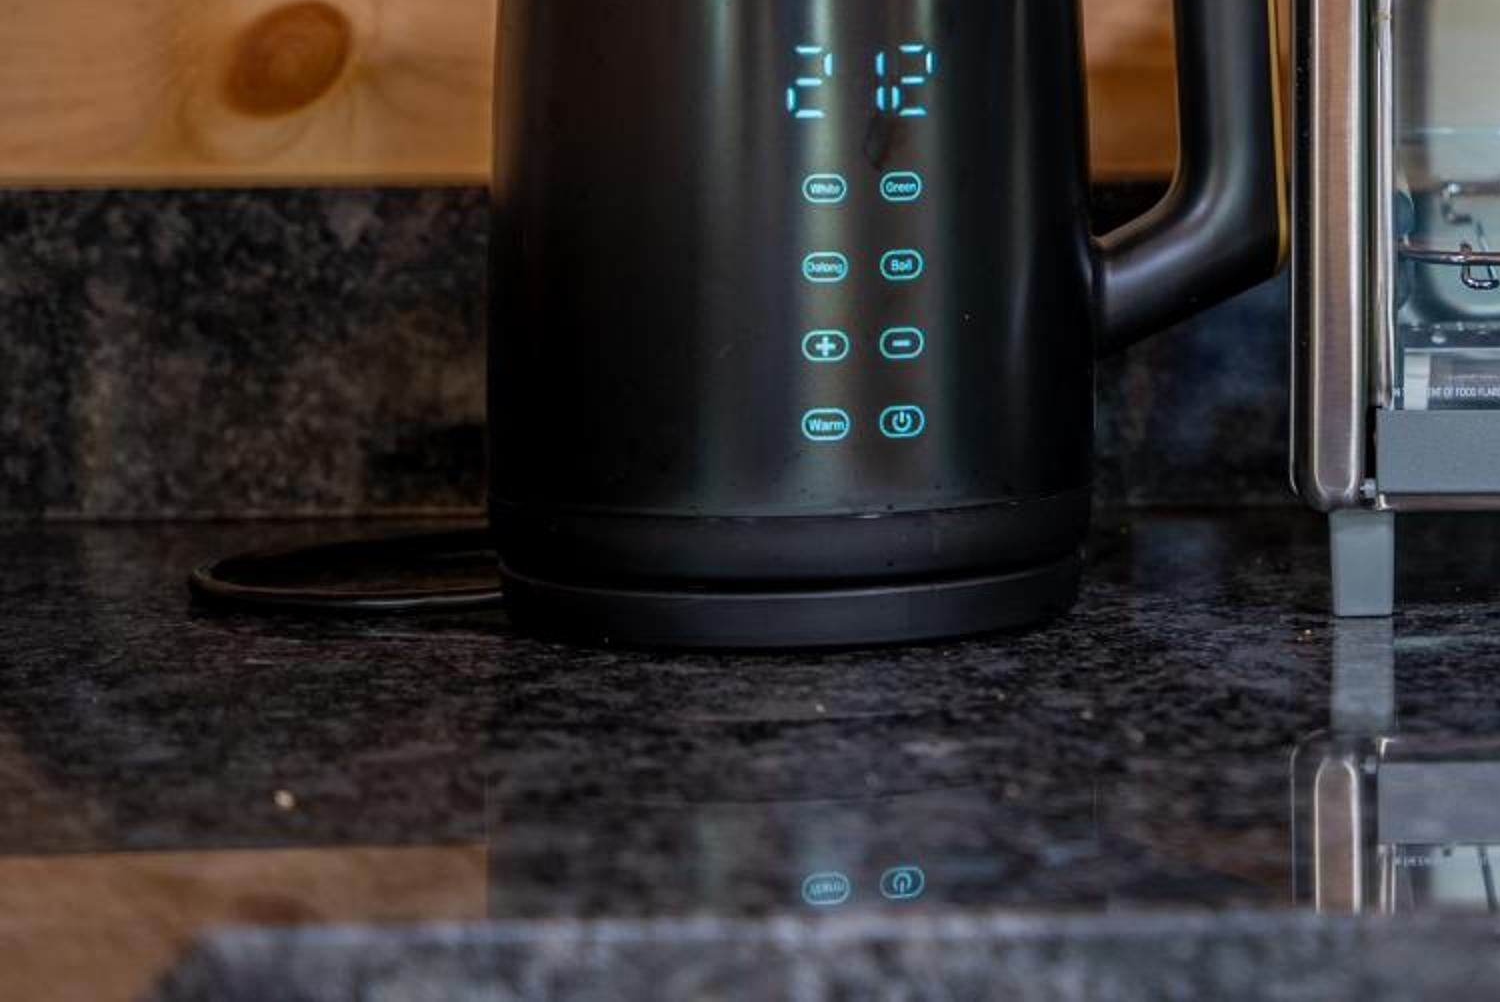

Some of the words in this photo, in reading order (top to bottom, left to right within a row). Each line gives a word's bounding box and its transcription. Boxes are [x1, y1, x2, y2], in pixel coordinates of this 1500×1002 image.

[885, 181, 917, 194] Green
[890, 258, 913, 272] Boil
[808, 419, 845, 432] Warm
